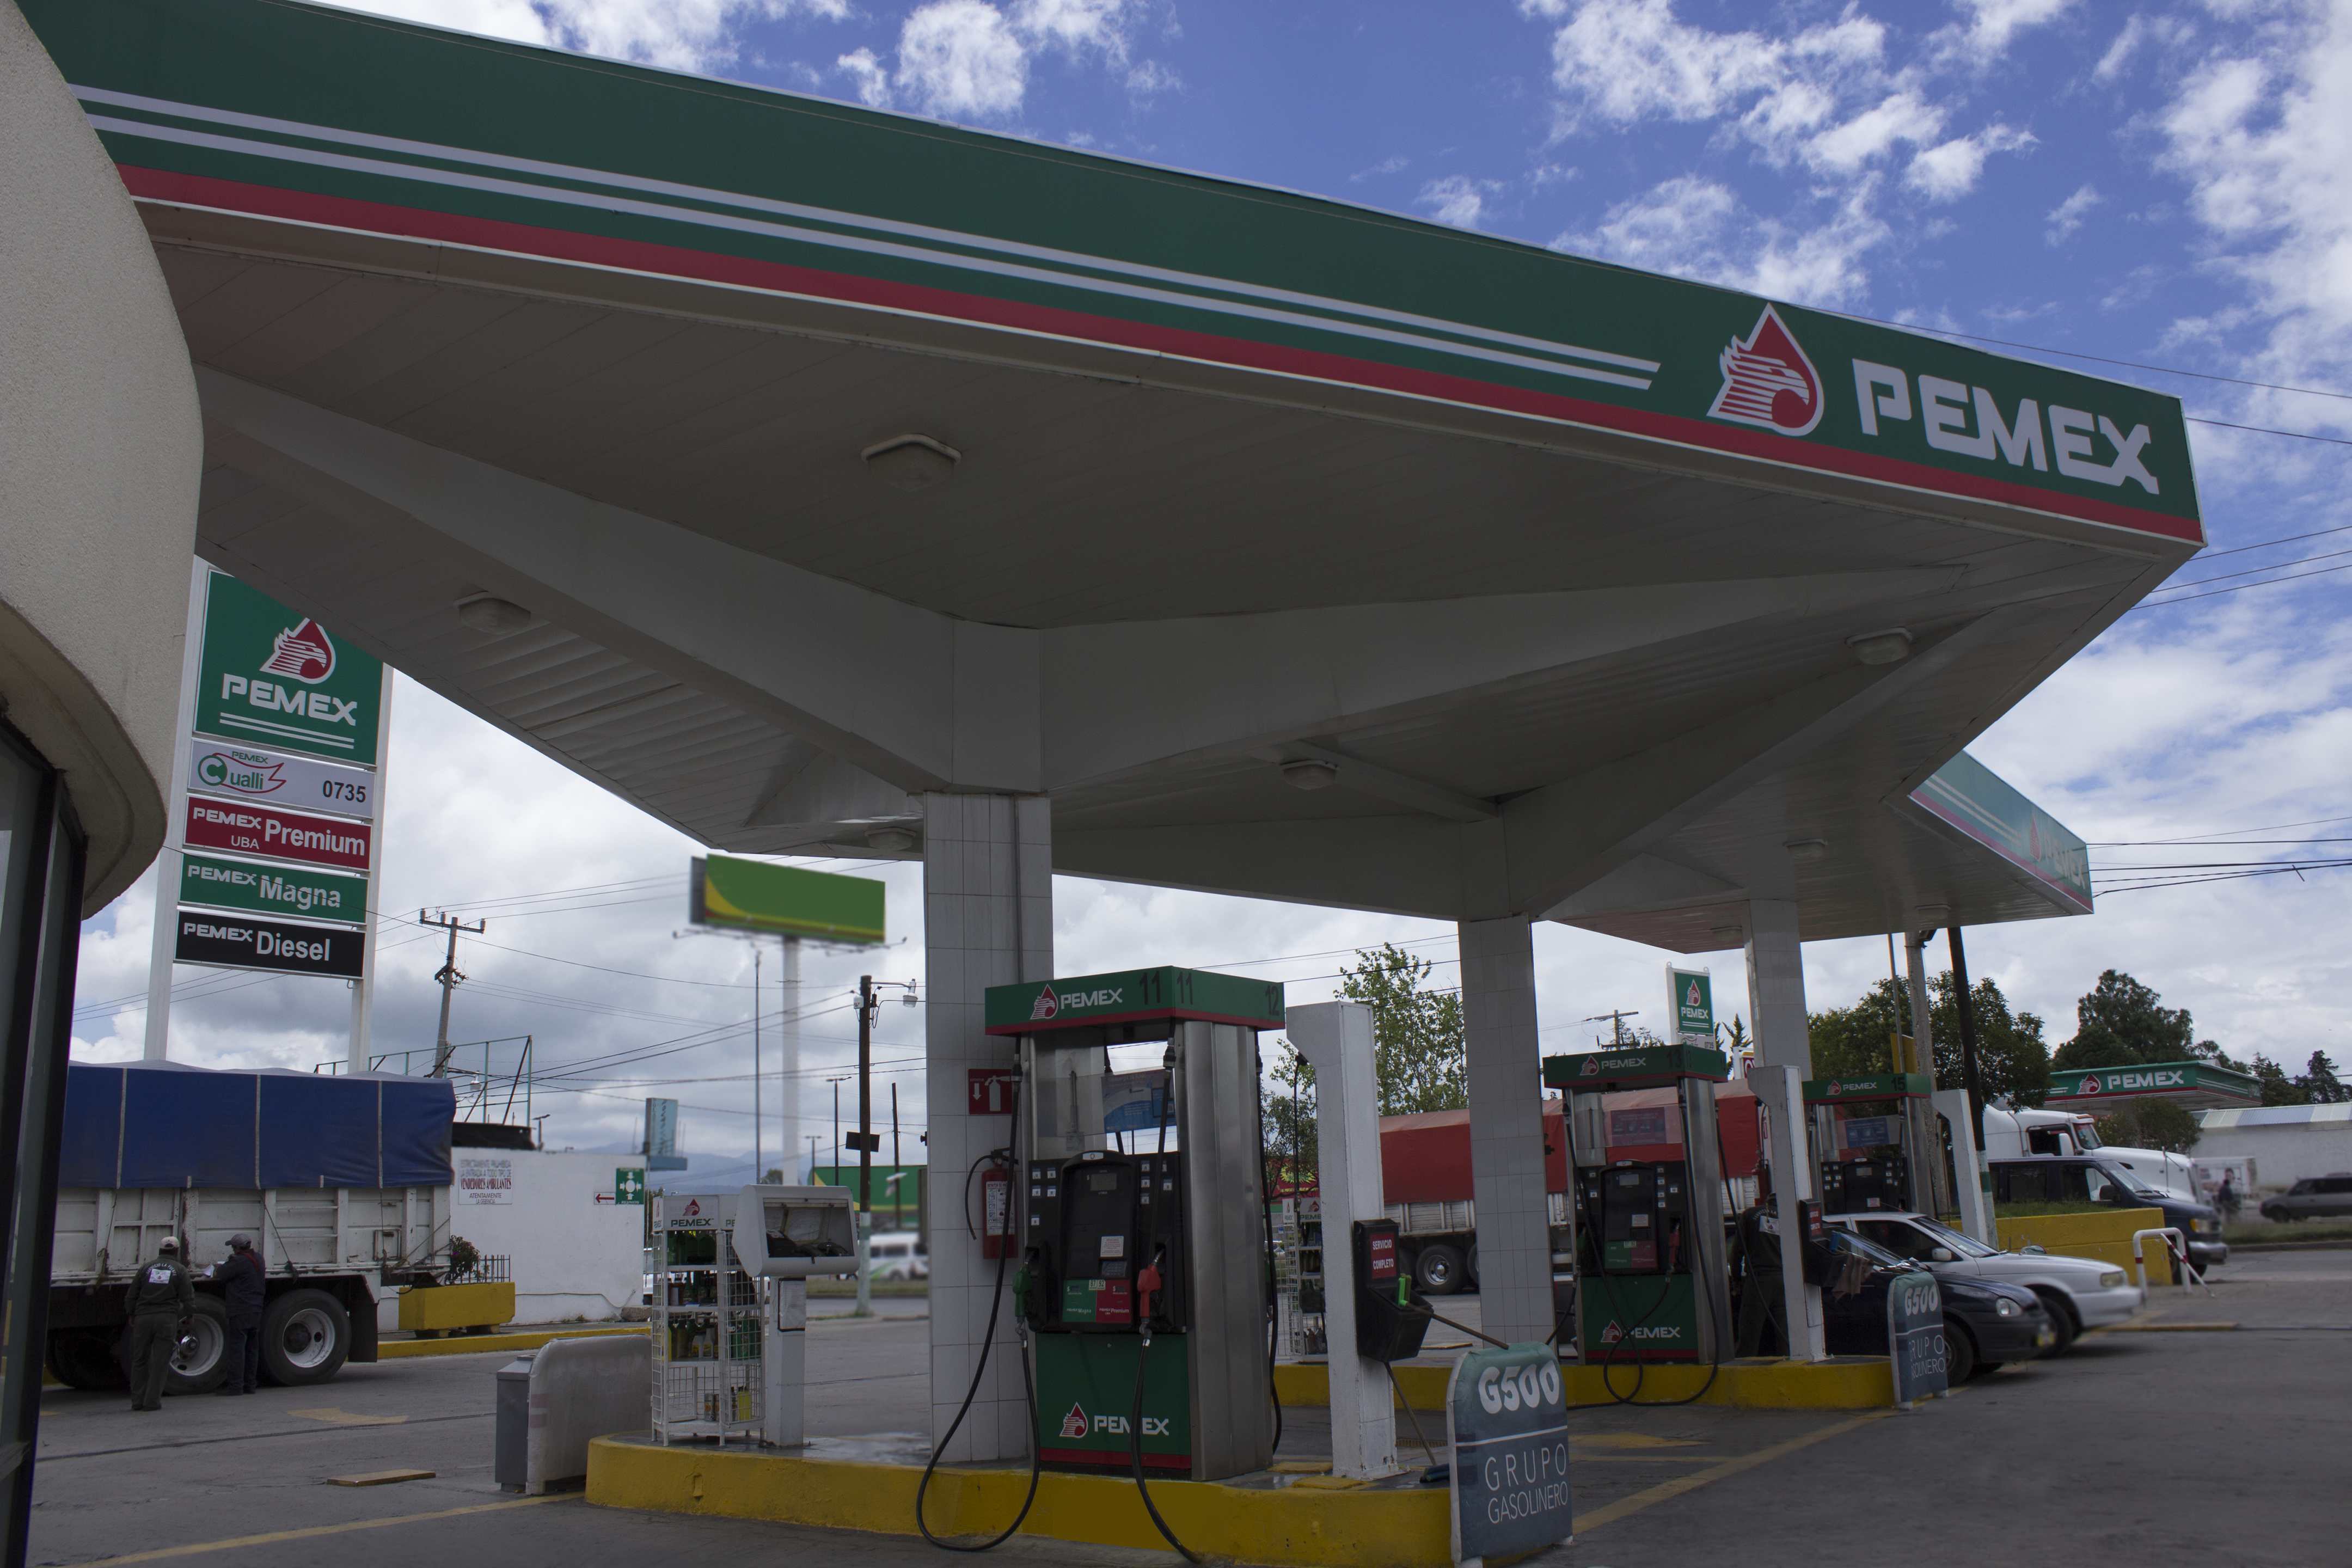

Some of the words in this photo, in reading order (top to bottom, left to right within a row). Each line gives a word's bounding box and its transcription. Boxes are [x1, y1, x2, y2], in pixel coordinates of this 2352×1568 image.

[1852, 359, 2159, 494] PEMEX
[222, 673, 358, 726] PEMEX
[232, 751, 269, 764] PEMEX
[198, 755, 264, 790] Cualli
[322, 780, 366, 803] 0735
[193, 807, 262, 829] PEMEX
[265, 819, 365, 855] Premium
[230, 835, 260, 849] UBA
[188, 865, 256, 886] PEMEX
[259, 875, 341, 910] Magna
[183, 922, 253, 942] PEMEX
[256, 931, 330, 961] Diesel
[1061, 988, 1122, 1009] PEMEX
[1140, 971, 1161, 1004] 11
[1176, 971, 1193, 1004] 11
[1265, 984, 1279, 1016] 12
[1681, 1007, 1708, 1019] PEMEX
[1601, 1057, 1646, 1069] PEMEX
[1667, 1049, 1681, 1068] 13
[1843, 1082, 1877, 1091] PEMEX
[1891, 1077, 1905, 1091] 15
[2108, 1070, 2184, 1089] PEMEX
[671, 1218, 712, 1227] PEMEX
[1373, 1239, 1392, 1250] SERVICIO
[1373, 1258, 1394, 1270] COMPLETO
[1905, 1283, 1938, 1316] G500
[1478, 1360, 1560, 1414] G500
[1485, 1443, 1566, 1491] GRUPO
[1488, 1481, 1568, 1524] GASOLINERO
